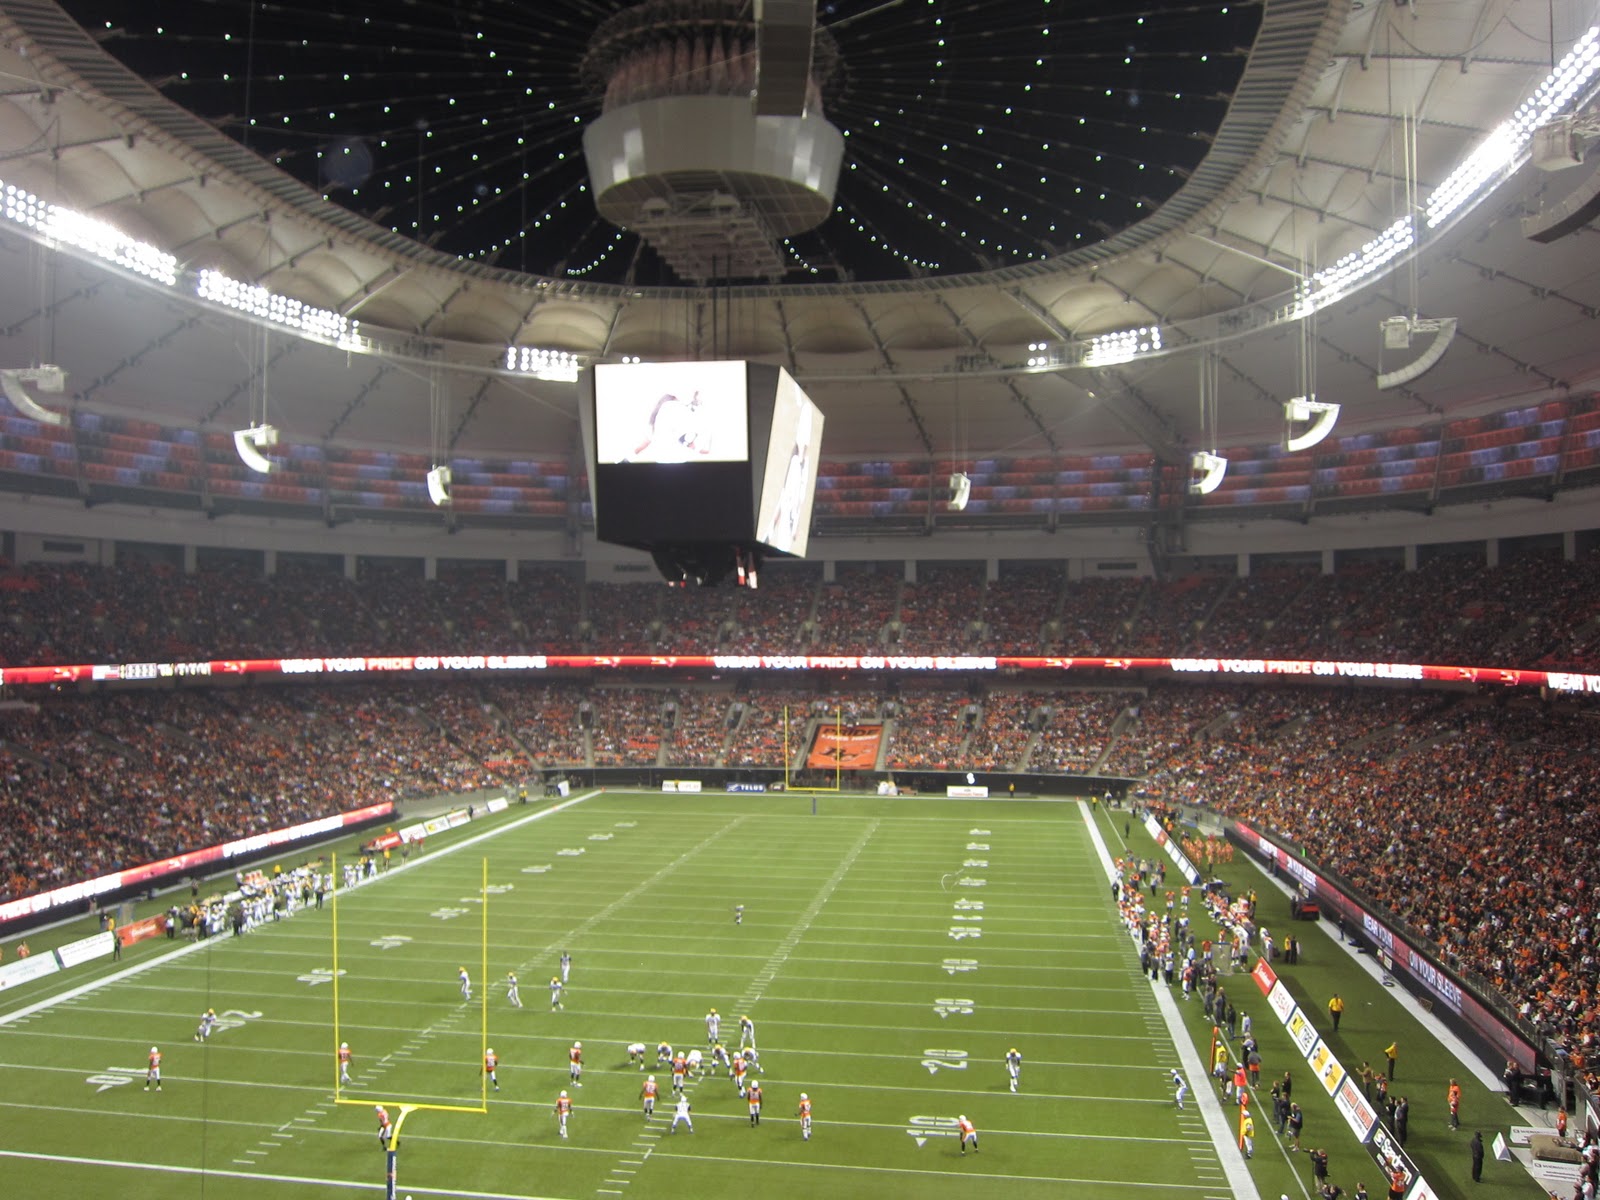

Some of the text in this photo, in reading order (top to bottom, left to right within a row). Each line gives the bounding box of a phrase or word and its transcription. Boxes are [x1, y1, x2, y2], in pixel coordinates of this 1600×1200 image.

[281, 659, 323, 673] WEAR
[325, 658, 365, 671] YOUR
[368, 658, 412, 670] PRIDE
[415, 657, 438, 669] ON
[440, 657, 485, 669] YOUR
[714, 656, 760, 668] WEAR
[762, 656, 807, 668] YOUR
[810, 657, 857, 668] PRIDE
[860, 657, 884, 668] ON
[888, 657, 933, 668] YOUR
[1170, 659, 1219, 671] WEAR
[1220, 659, 1265, 672] YOUR
[1268, 661, 1311, 673] PRIDE
[1313, 662, 1334, 674] ON
[1336, 662, 1374, 676] YOUR
[1547, 672, 1584, 690] WEAR
[740, 783, 764, 791] TELUS
[1378, 924, 1393, 949] YOUR
[1418, 957, 1436, 986] YOUR
[1436, 972, 1462, 1008] SLEEVE
[921, 1049, 968, 1070] 20
[906, 1115, 960, 1137] 10
